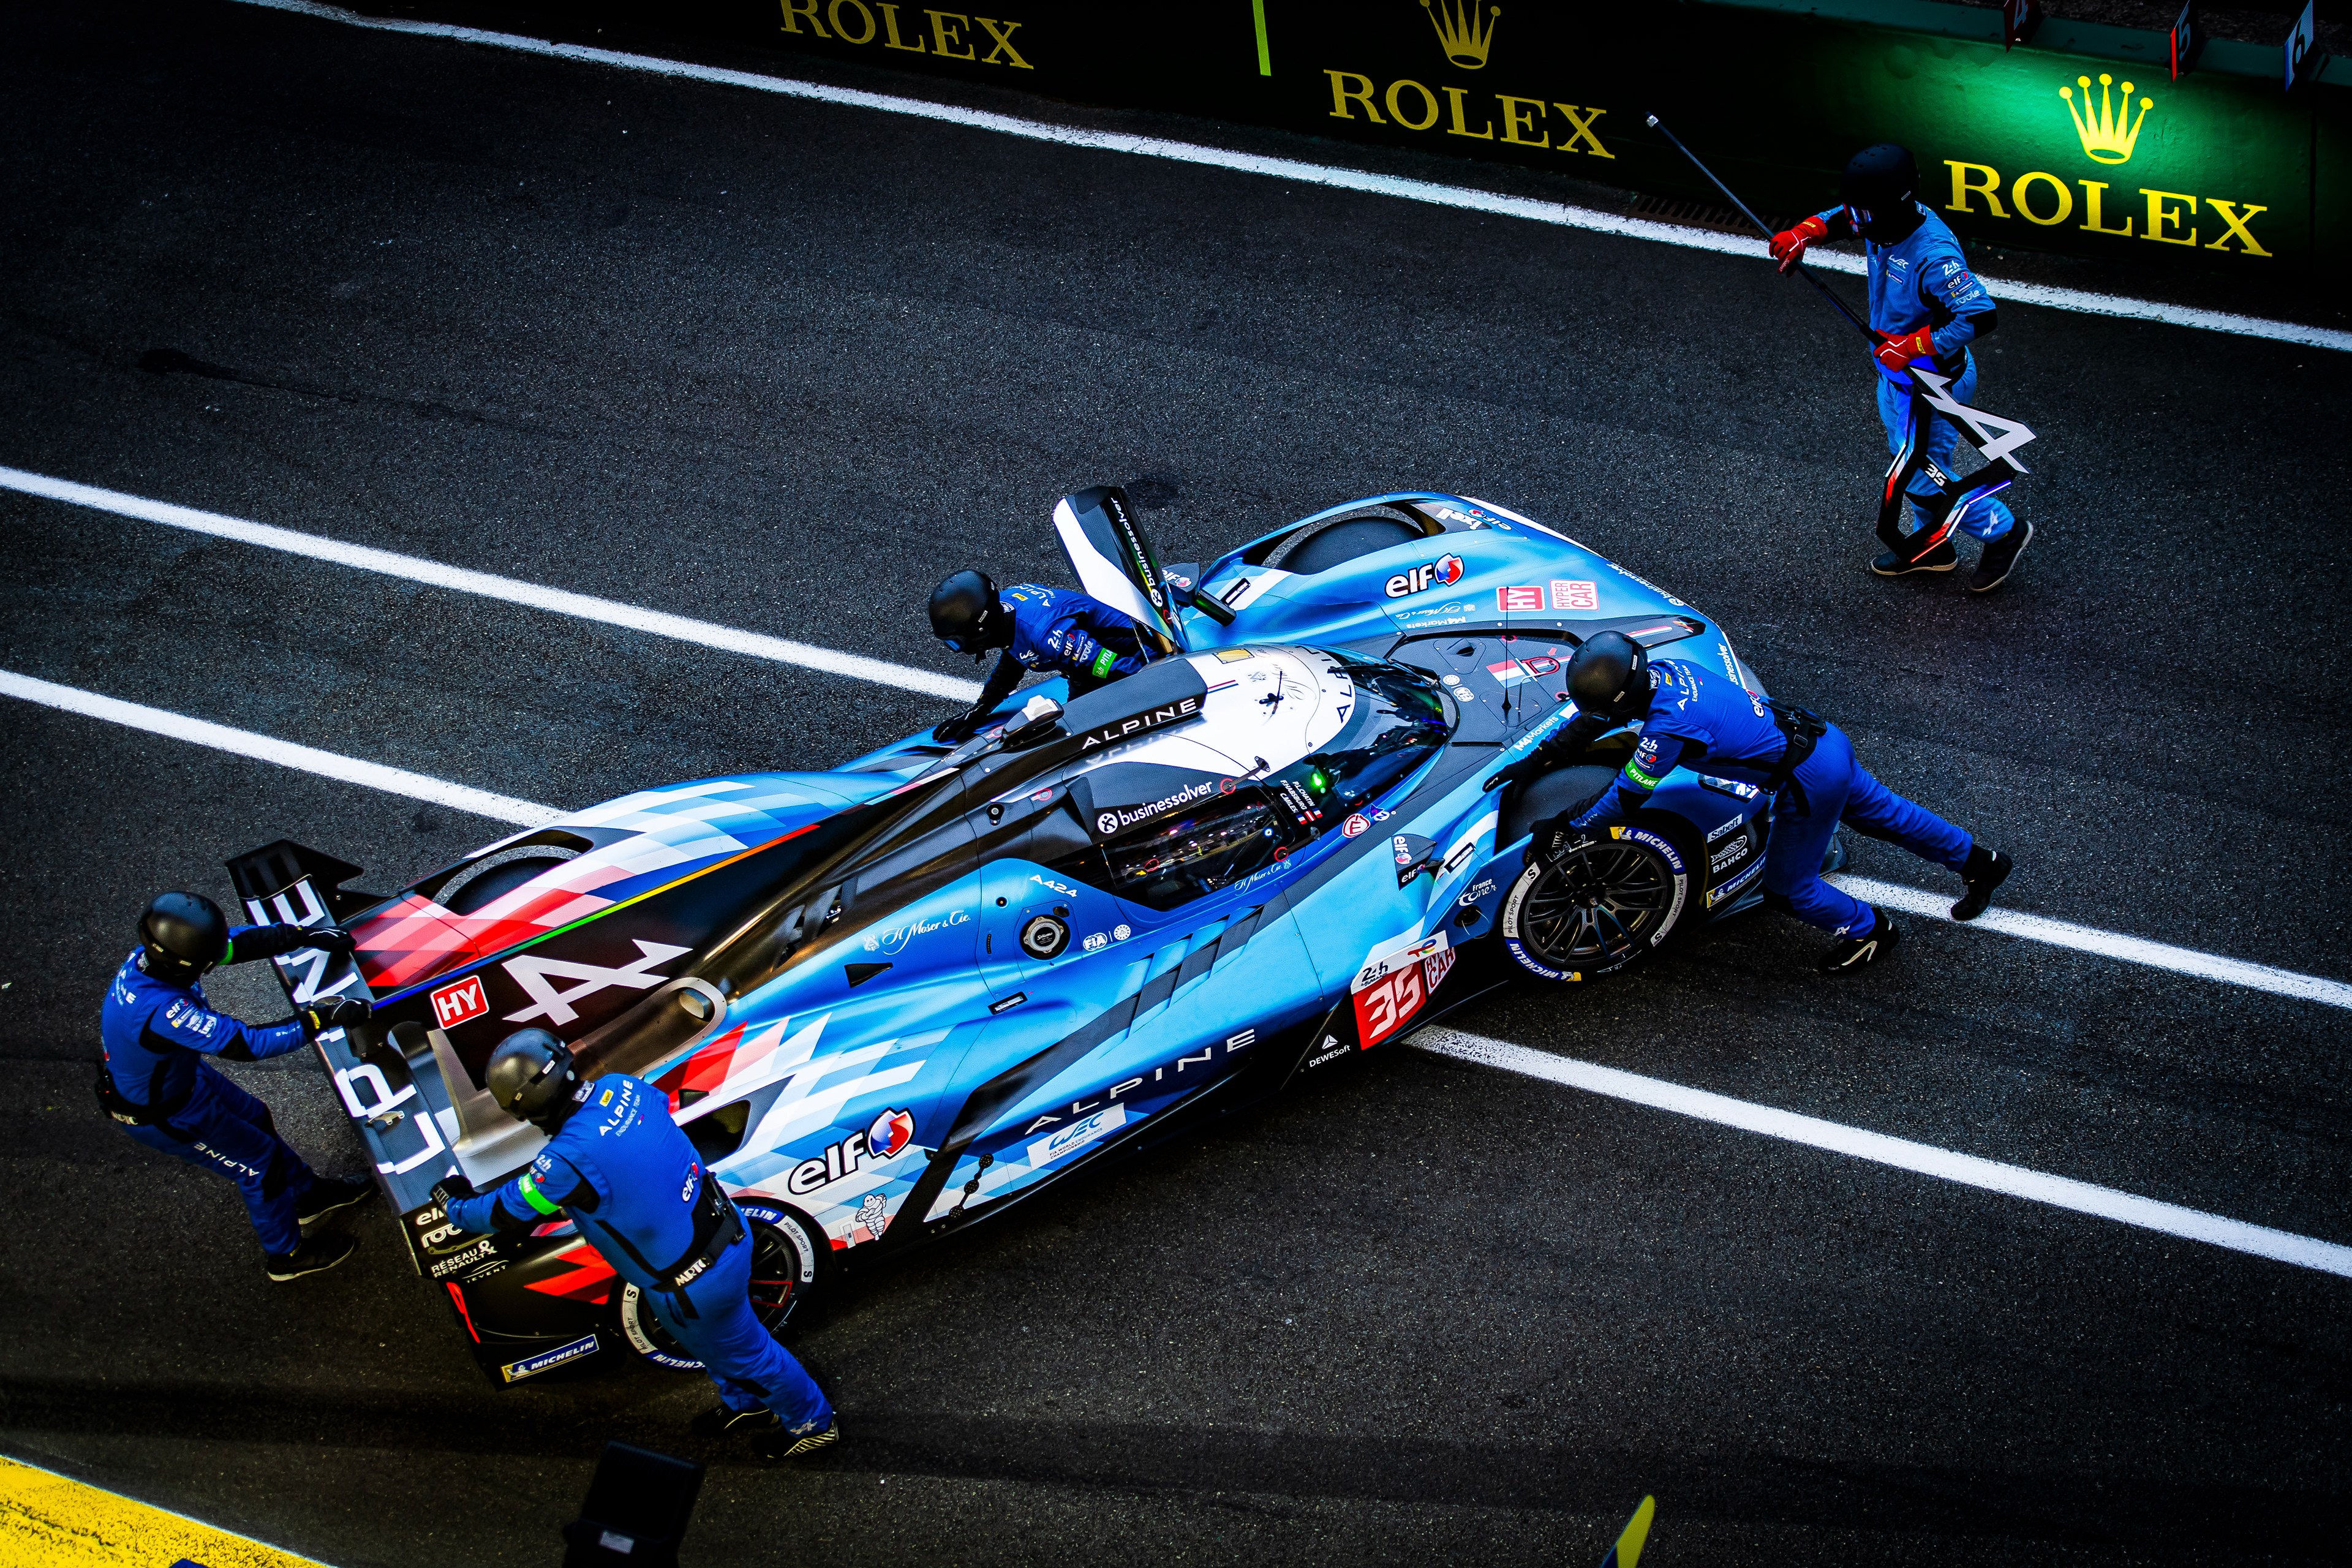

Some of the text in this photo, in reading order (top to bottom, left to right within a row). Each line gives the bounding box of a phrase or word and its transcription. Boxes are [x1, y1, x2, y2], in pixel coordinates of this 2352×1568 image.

[781, 0, 1034, 70] ROLEX
[1324, 69, 1615, 159] ROLEX
[1943, 160, 2272, 257] ROLEX
[1948, 275, 1961, 288] elf
[1925, 463, 1945, 487] 35
[1110, 497, 1156, 587] businessolver
[1386, 564, 1433, 598] elf
[1606, 563, 1672, 599] businessolver
[1507, 588, 1536, 609] HY
[1556, 582, 1567, 608] HYPER
[1572, 582, 1593, 608] CAR
[1064, 640, 1073, 656] elf
[1688, 676, 1698, 702] ENDURANCE
[1752, 696, 1765, 717] elf
[1082, 698, 1196, 750] ALPINE
[1630, 768, 1658, 786] PITLANE
[1118, 782, 1213, 826] businessolver
[1711, 817, 1739, 840] Sabelt
[1394, 836, 1409, 858] elf
[1635, 831, 1682, 870] MICHELIN
[1713, 848, 1748, 873] BAHCO
[1030, 874, 1077, 897] A424
[1401, 871, 1417, 883] elf
[1472, 878, 1492, 892] France
[1528, 869, 1536, 880] S
[1510, 895, 1519, 916] SPORT
[1672, 897, 1682, 917] SPORT
[1654, 932, 1663, 941] S
[1429, 947, 1455, 989] CAR
[1510, 943, 1559, 979] MICHELIN
[166, 1003, 181, 1019] elf
[437, 983, 478, 1020] HY
[1364, 964, 1421, 1039] 35
[1309, 1045, 1351, 1068] DEWESoft
[1025, 1029, 1255, 1135] ALPINE
[599, 1079, 633, 1137] ALPINE
[615, 1107, 638, 1138] ENDURANCE
[1049, 1112, 1104, 1151] WEC
[1050, 1140, 1085, 1159] CHAMPIONSHIP
[1058, 1142, 1075, 1152] WORLD
[1076, 1128, 1103, 1144] ENDURANCE
[194, 1142, 260, 1177] ALPINE
[790, 1132, 864, 1194] elf
[783, 1222, 809, 1253] PILOT SPORT
[431, 1248, 478, 1274] RÉSEAU
[434, 1253, 486, 1278] RENAULT
[804, 1270, 812, 1278] S
[627, 1289, 637, 1299] S
[627, 1317, 638, 1336] SPORT
[530, 1340, 595, 1370] MICHELIN
